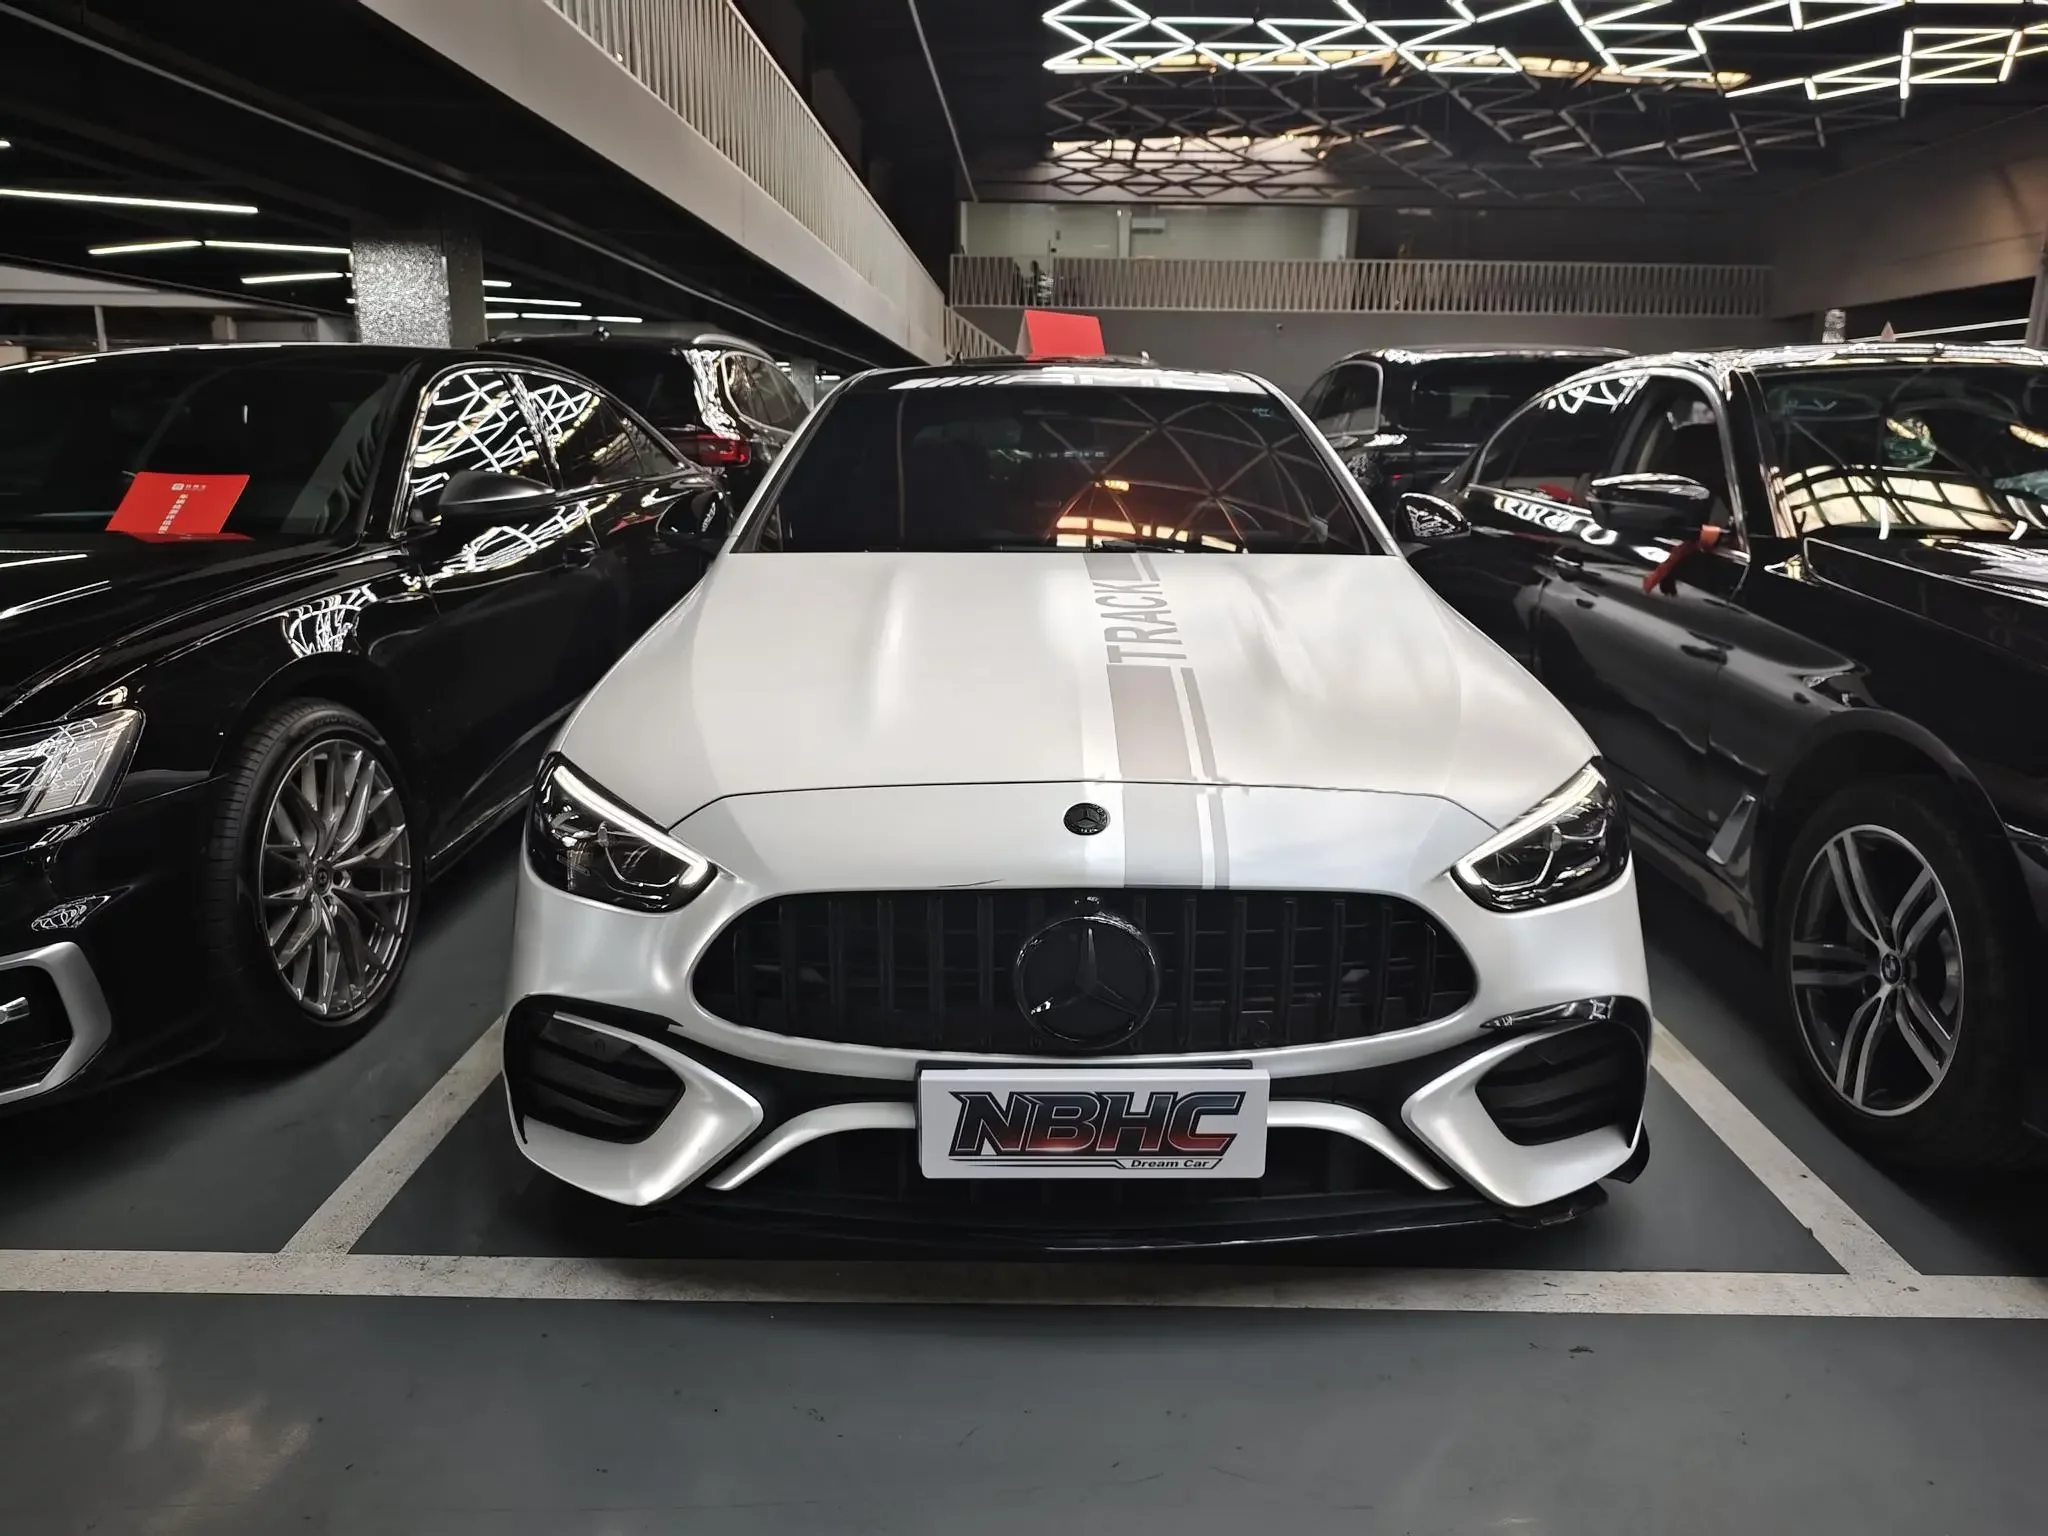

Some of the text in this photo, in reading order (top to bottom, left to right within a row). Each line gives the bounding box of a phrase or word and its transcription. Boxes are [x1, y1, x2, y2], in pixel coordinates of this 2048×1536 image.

[1092, 582, 1187, 663] TRACK
[948, 1090, 1246, 1156] NBHC
[1131, 1159, 1209, 1168] Dream Car
